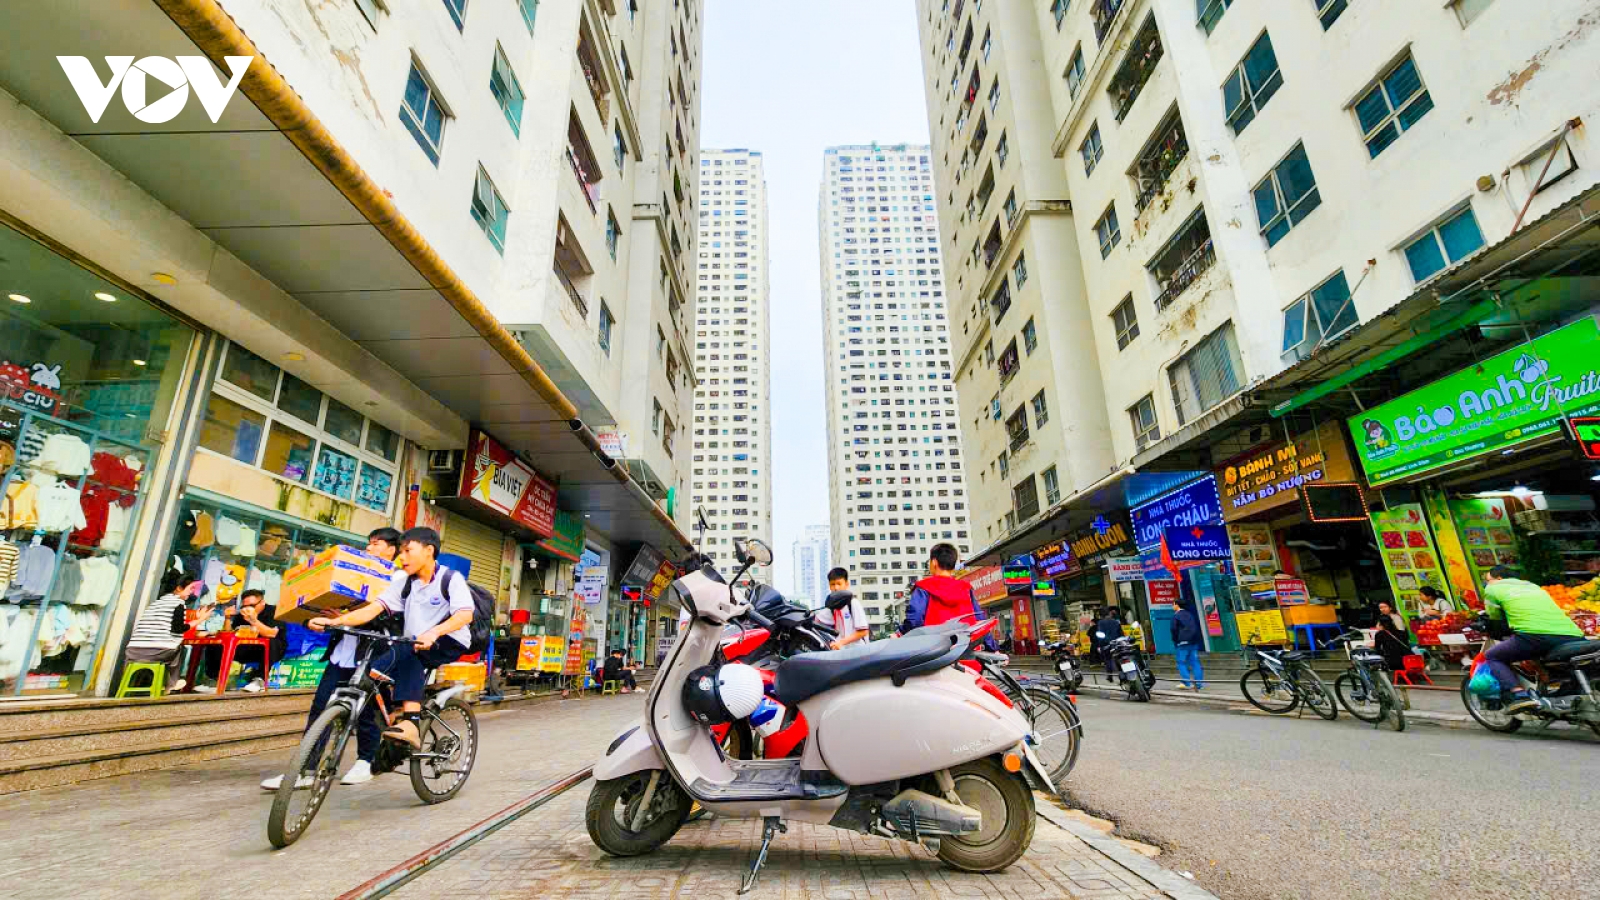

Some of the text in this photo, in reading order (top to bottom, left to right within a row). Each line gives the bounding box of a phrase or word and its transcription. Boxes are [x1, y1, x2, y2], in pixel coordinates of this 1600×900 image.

[1393, 405, 1455, 441] Bảo
[1458, 374, 1527, 418] Anh
[493, 467, 507, 490] BIA
[1149, 491, 1191, 519] NHÀ THUỐC
[1173, 503, 1209, 527] CHÂU
[1172, 547, 1231, 558] LONG CHÂU
[1196, 539, 1218, 547] THUỐC
